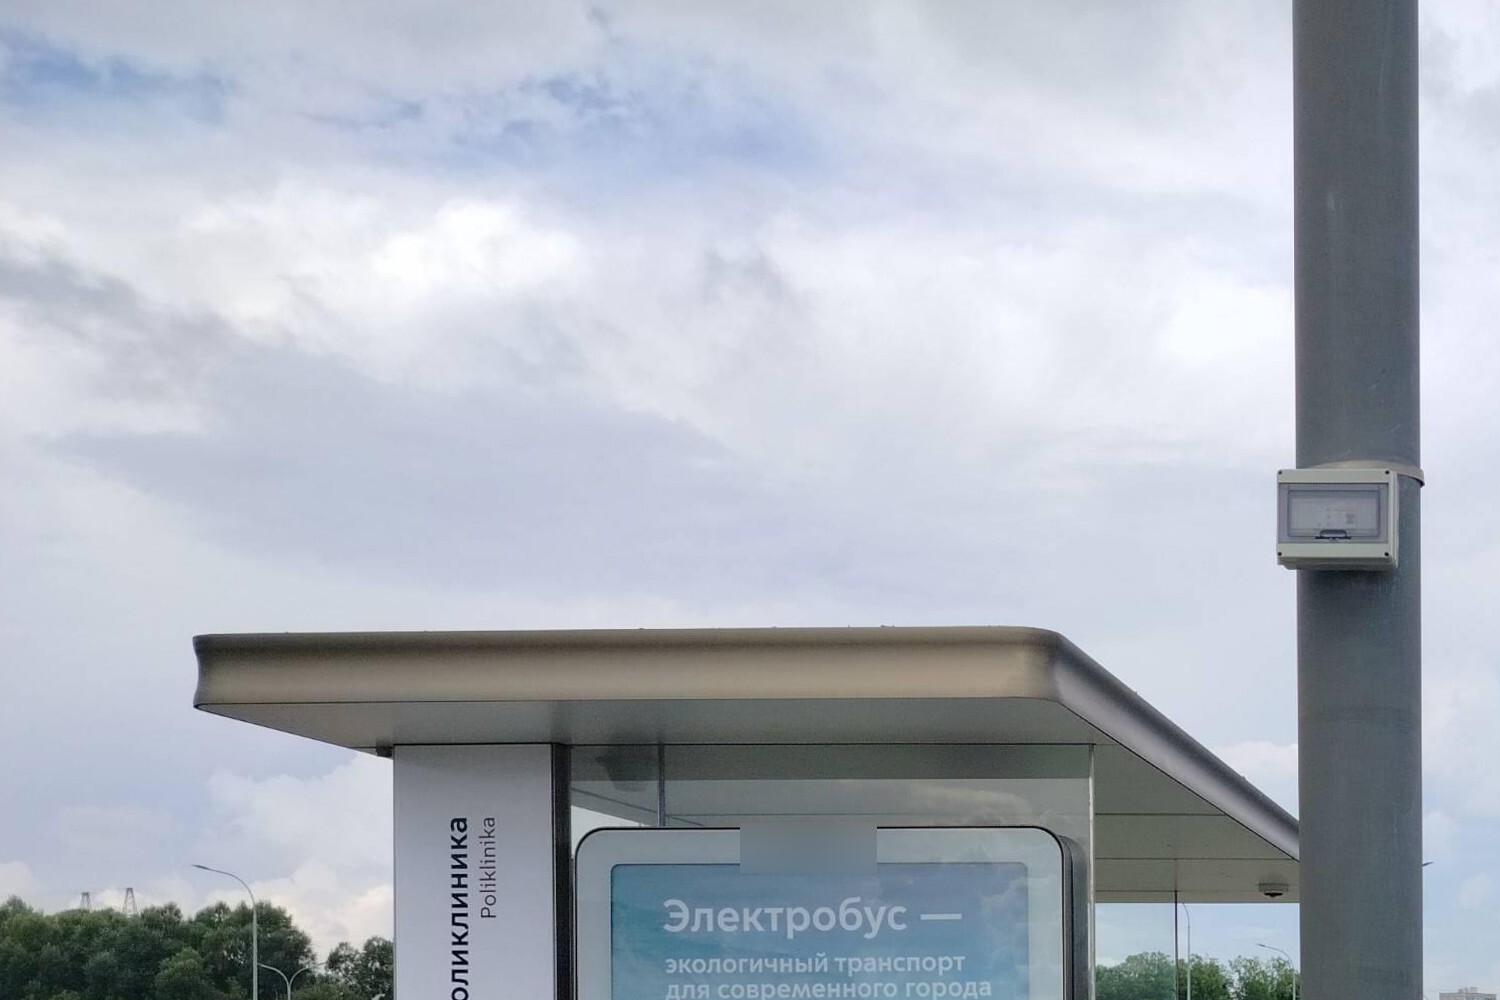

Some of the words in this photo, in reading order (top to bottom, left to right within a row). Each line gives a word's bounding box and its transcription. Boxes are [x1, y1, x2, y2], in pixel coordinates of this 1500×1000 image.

[478, 816, 498, 919] Poliklinika
[662, 896, 908, 940] Электробус
[665, 952, 829, 975] экологичный
[835, 955, 966, 977] транспорт
[905, 979, 992, 1000] города
